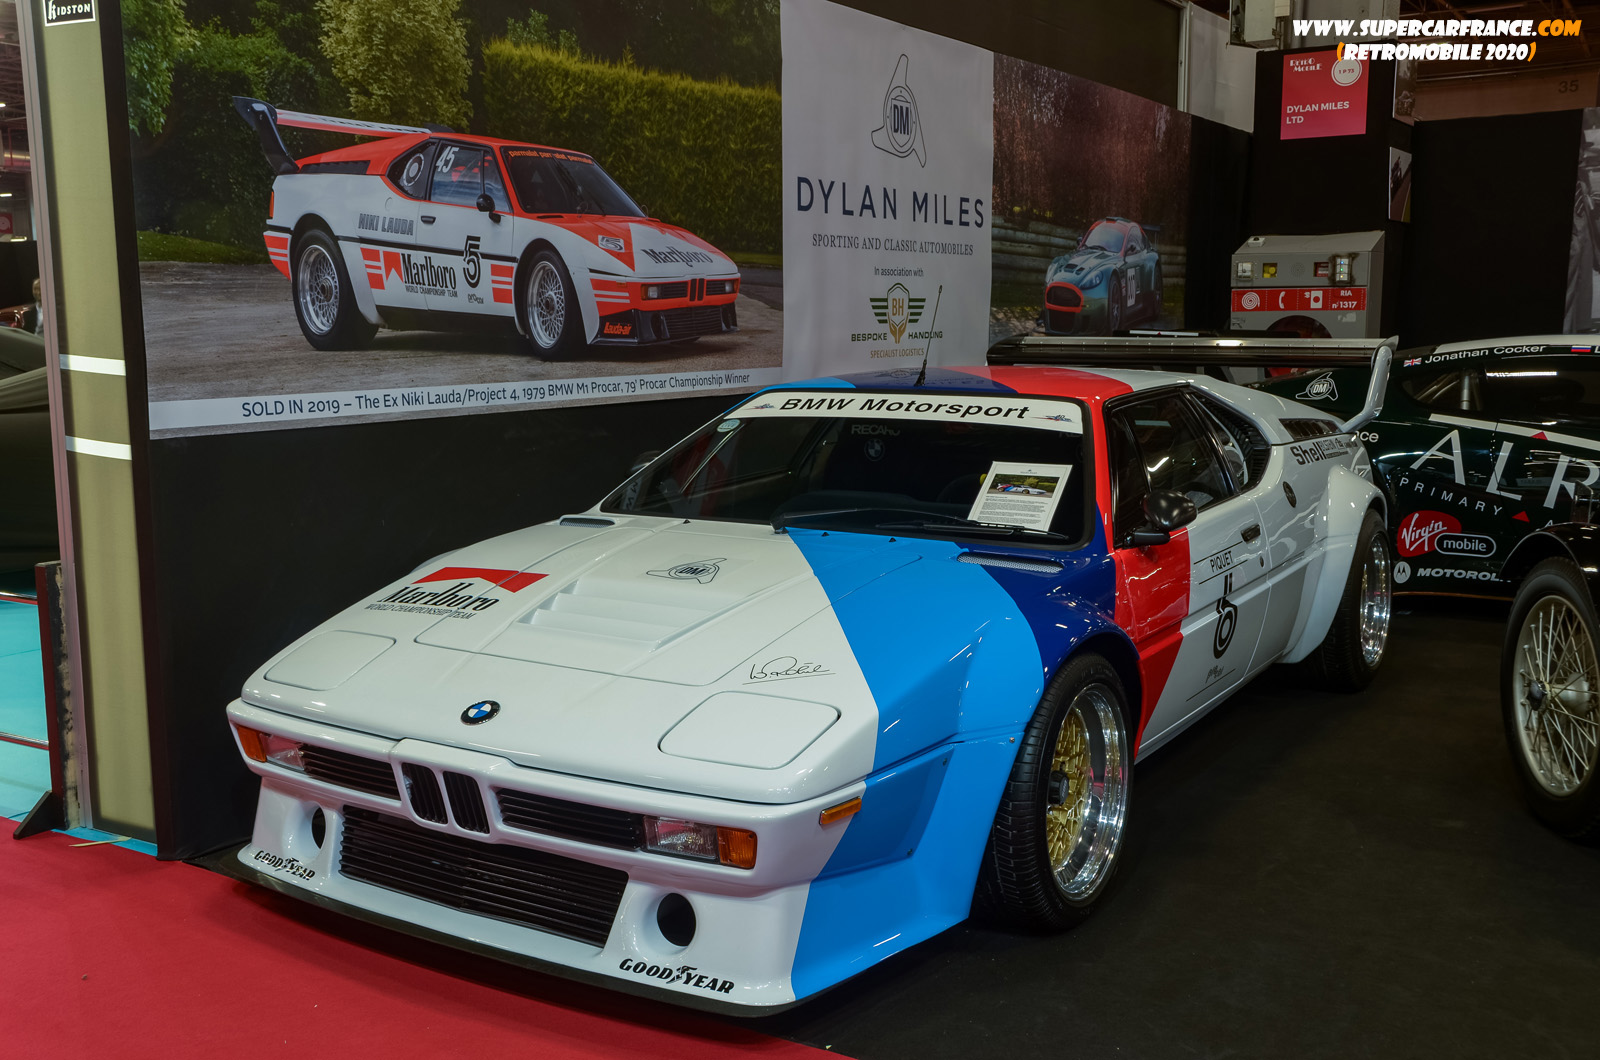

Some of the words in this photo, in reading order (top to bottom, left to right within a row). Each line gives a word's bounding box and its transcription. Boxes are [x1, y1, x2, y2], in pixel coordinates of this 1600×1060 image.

[48, 0, 91, 20] KIDSTON
[1557, 80, 1580, 94] 35
[1286, 104, 1319, 114] DYLAN
[1320, 101, 1350, 111] MILES
[893, 104, 910, 136] DM
[1286, 115, 1304, 124] LTD
[435, 146, 459, 173] 45
[539, 151, 568, 160] paralat
[797, 176, 897, 220] DYLAN
[912, 191, 984, 228] MILES
[358, 213, 379, 232] NIKI
[381, 216, 414, 236] LAUDA
[812, 233, 860, 250] SPORTING
[861, 237, 881, 250] AND
[884, 238, 917, 253] CLASSIC
[919, 241, 974, 256] AUTOMOBILES
[463, 235, 481, 289] 5
[640, 246, 713, 267] Marlboro
[401, 253, 457, 290] Marlboro
[874, 266, 880, 276] In
[880, 266, 912, 277] association
[913, 267, 924, 277] with
[405, 285, 418, 294] WORLD
[447, 290, 458, 298] TEAM
[892, 298, 904, 316] BH
[851, 333, 887, 342] BESPOKE
[908, 331, 943, 340] HANDLING
[870, 349, 898, 358] SPECIALIST
[899, 347, 925, 357] LOGISTICS
[1424, 349, 1489, 364] Jonathan
[1493, 345, 1547, 355] Cocker
[242, 400, 285, 417] SOLD
[289, 399, 303, 414] IN
[308, 399, 340, 414] 2019
[355, 395, 380, 410] The
[384, 393, 399, 407] Ex
[401, 390, 425, 406] Niki
[427, 386, 507, 405] Lauda/Project
[510, 389, 520, 401] 4,
[522, 387, 545, 401] 1979
[548, 383, 574, 397] BMW
[576, 381, 590, 395] M1
[591, 380, 623, 394] Procar,
[639, 377, 667, 390] Procar
[669, 373, 723, 389] Championship
[724, 373, 750, 385] Winner
[1311, 383, 1328, 393] DM
[779, 398, 854, 411] BMW
[858, 398, 1030, 419] Motorsport
[1289, 440, 1327, 465] Shell
[1400, 477, 1503, 516] PRIMARY
[1401, 512, 1448, 552] Virgin
[1443, 539, 1487, 551] mobile
[679, 566, 706, 576] DM
[1209, 550, 1234, 573] PIQUET
[1417, 567, 1511, 582] MOTOROL
[377, 582, 500, 612] Marlboro
[364, 603, 391, 613] WORLD
[389, 605, 450, 617] CHAMPIONSHIP
[448, 611, 478, 620] TEAM
[1213, 572, 1238, 659] 6
